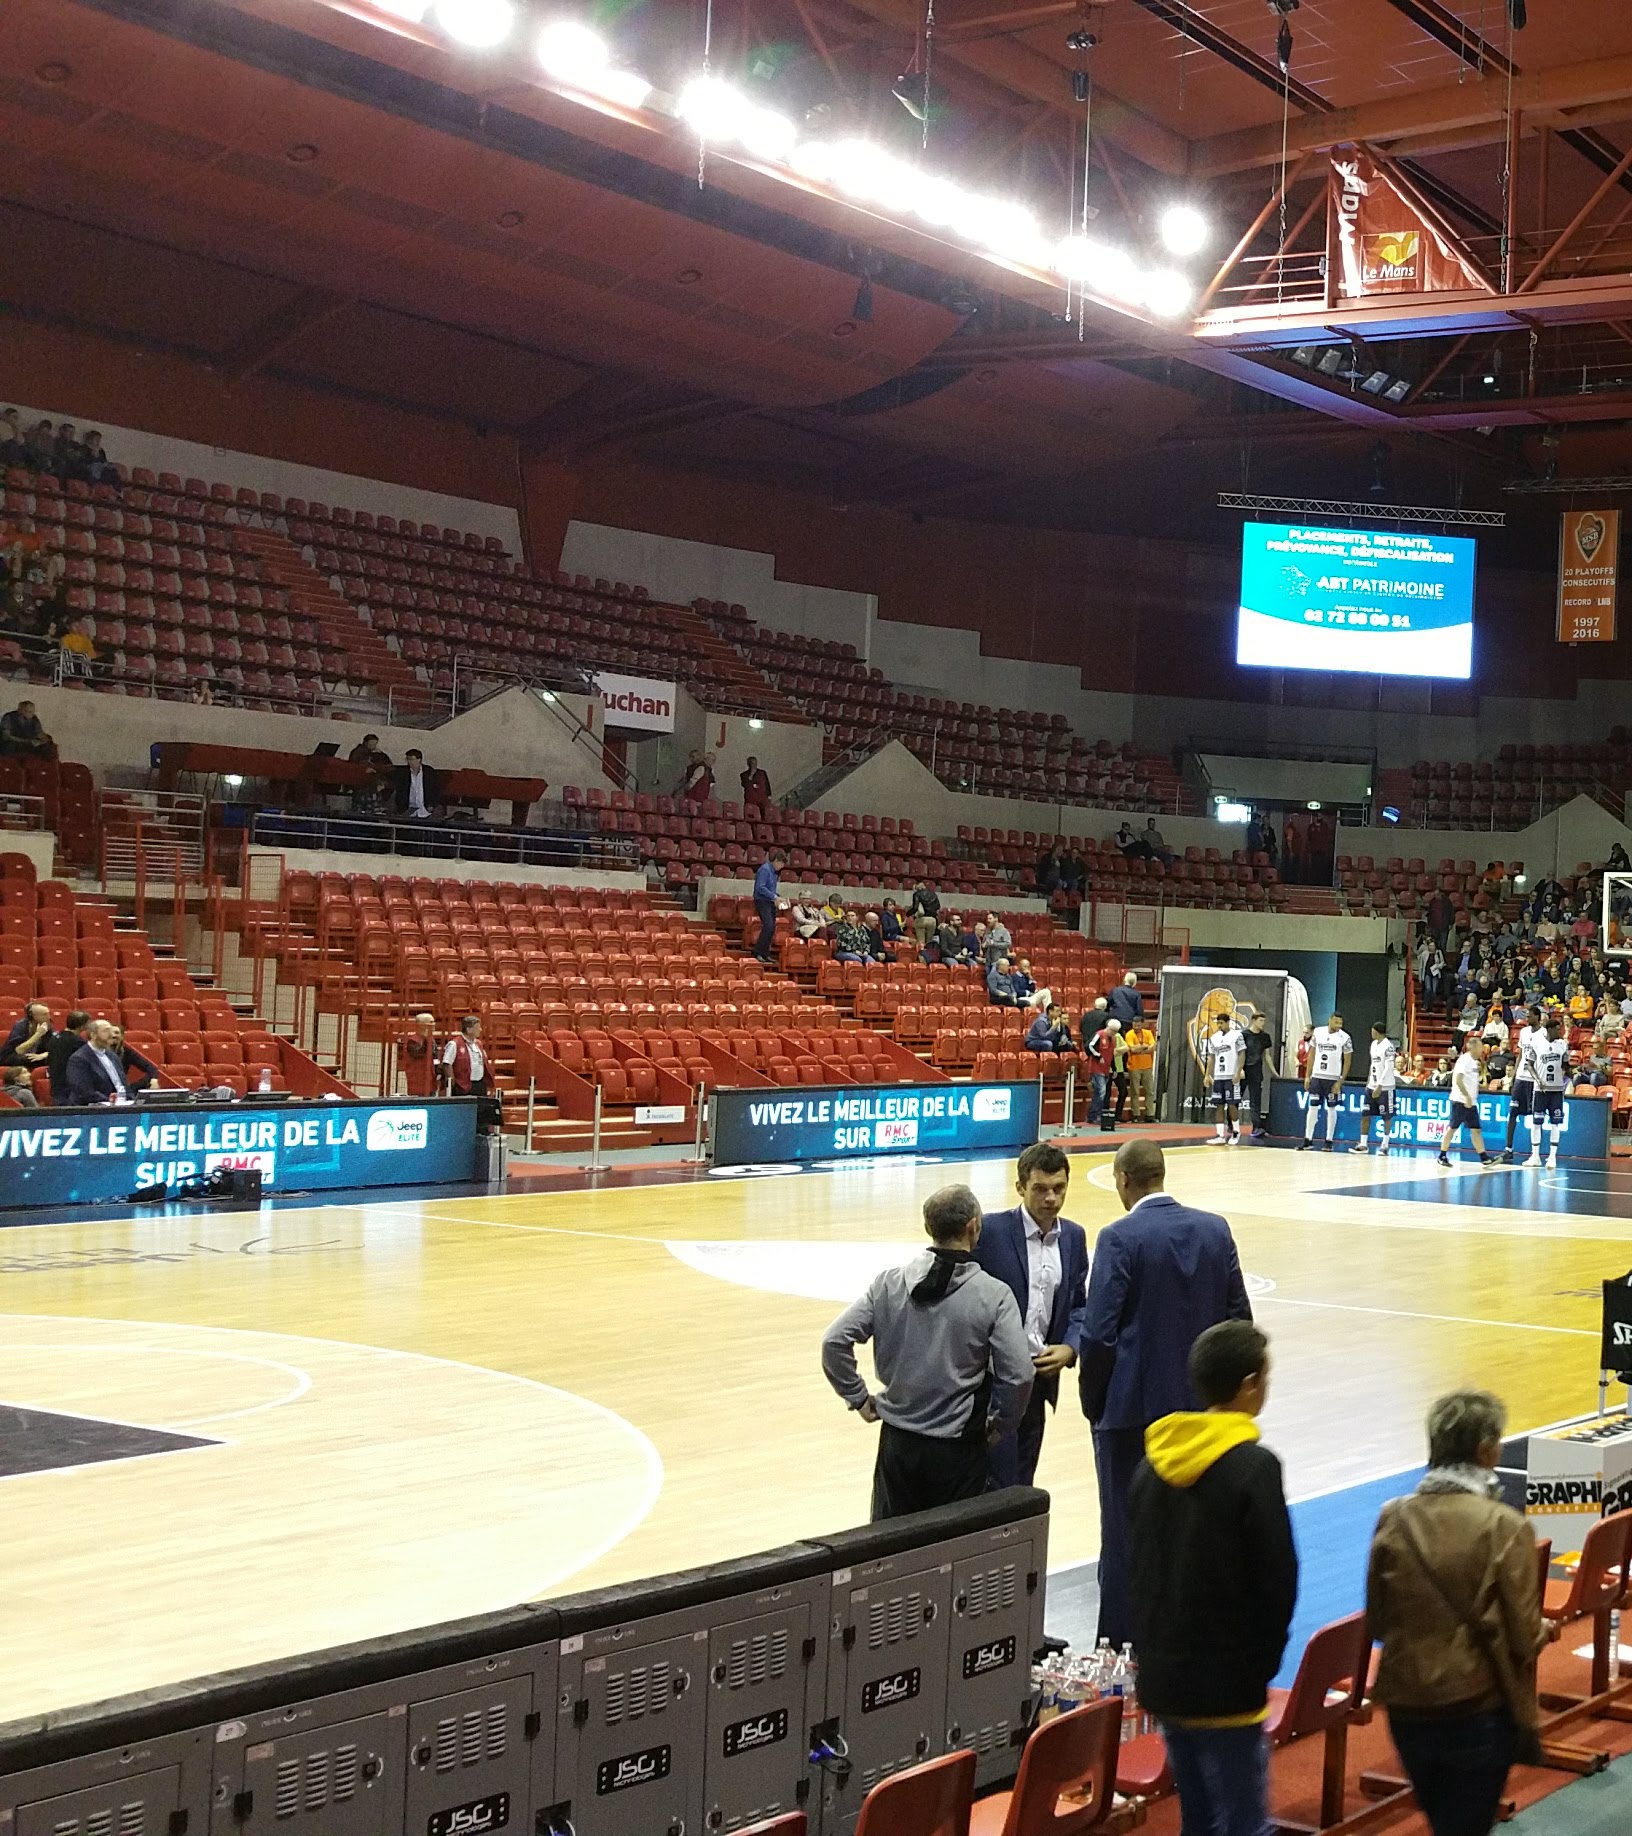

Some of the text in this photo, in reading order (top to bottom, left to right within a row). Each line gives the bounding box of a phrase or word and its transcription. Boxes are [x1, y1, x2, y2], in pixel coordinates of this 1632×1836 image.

[1363, 264, 1415, 279] Le Mans
[1562, 577, 1616, 587] CONSECUTIFS
[1575, 566, 1614, 576] PLAYOFFS
[1353, 578, 1445, 597] PATRIMOINE
[1564, 598, 1592, 606] RECORD
[1572, 628, 1599, 638] 2016
[1573, 617, 1600, 627] 1997
[600, 691, 670, 717] uchan
[715, 721, 726, 748] J
[750, 1095, 970, 1126] VIVEZ LE MEILLEUR DE LA
[89, 1126, 128, 1155] LE
[134, 1121, 277, 1152] MEILLEUR
[283, 1120, 319, 1147] DE
[325, 1118, 360, 1145] LA
[397, 1121, 423, 1132] Jeep
[834, 1124, 910, 1150] SUR RMC
[135, 1161, 197, 1189] SUR
[1526, 1481, 1602, 1505] GRAPHI
[974, 1644, 1005, 1668] JSC
[875, 1675, 908, 1700] JSC
[737, 1718, 774, 1744] JSC
[613, 1754, 655, 1782] JSC
[445, 1803, 492, 1834] JSC
